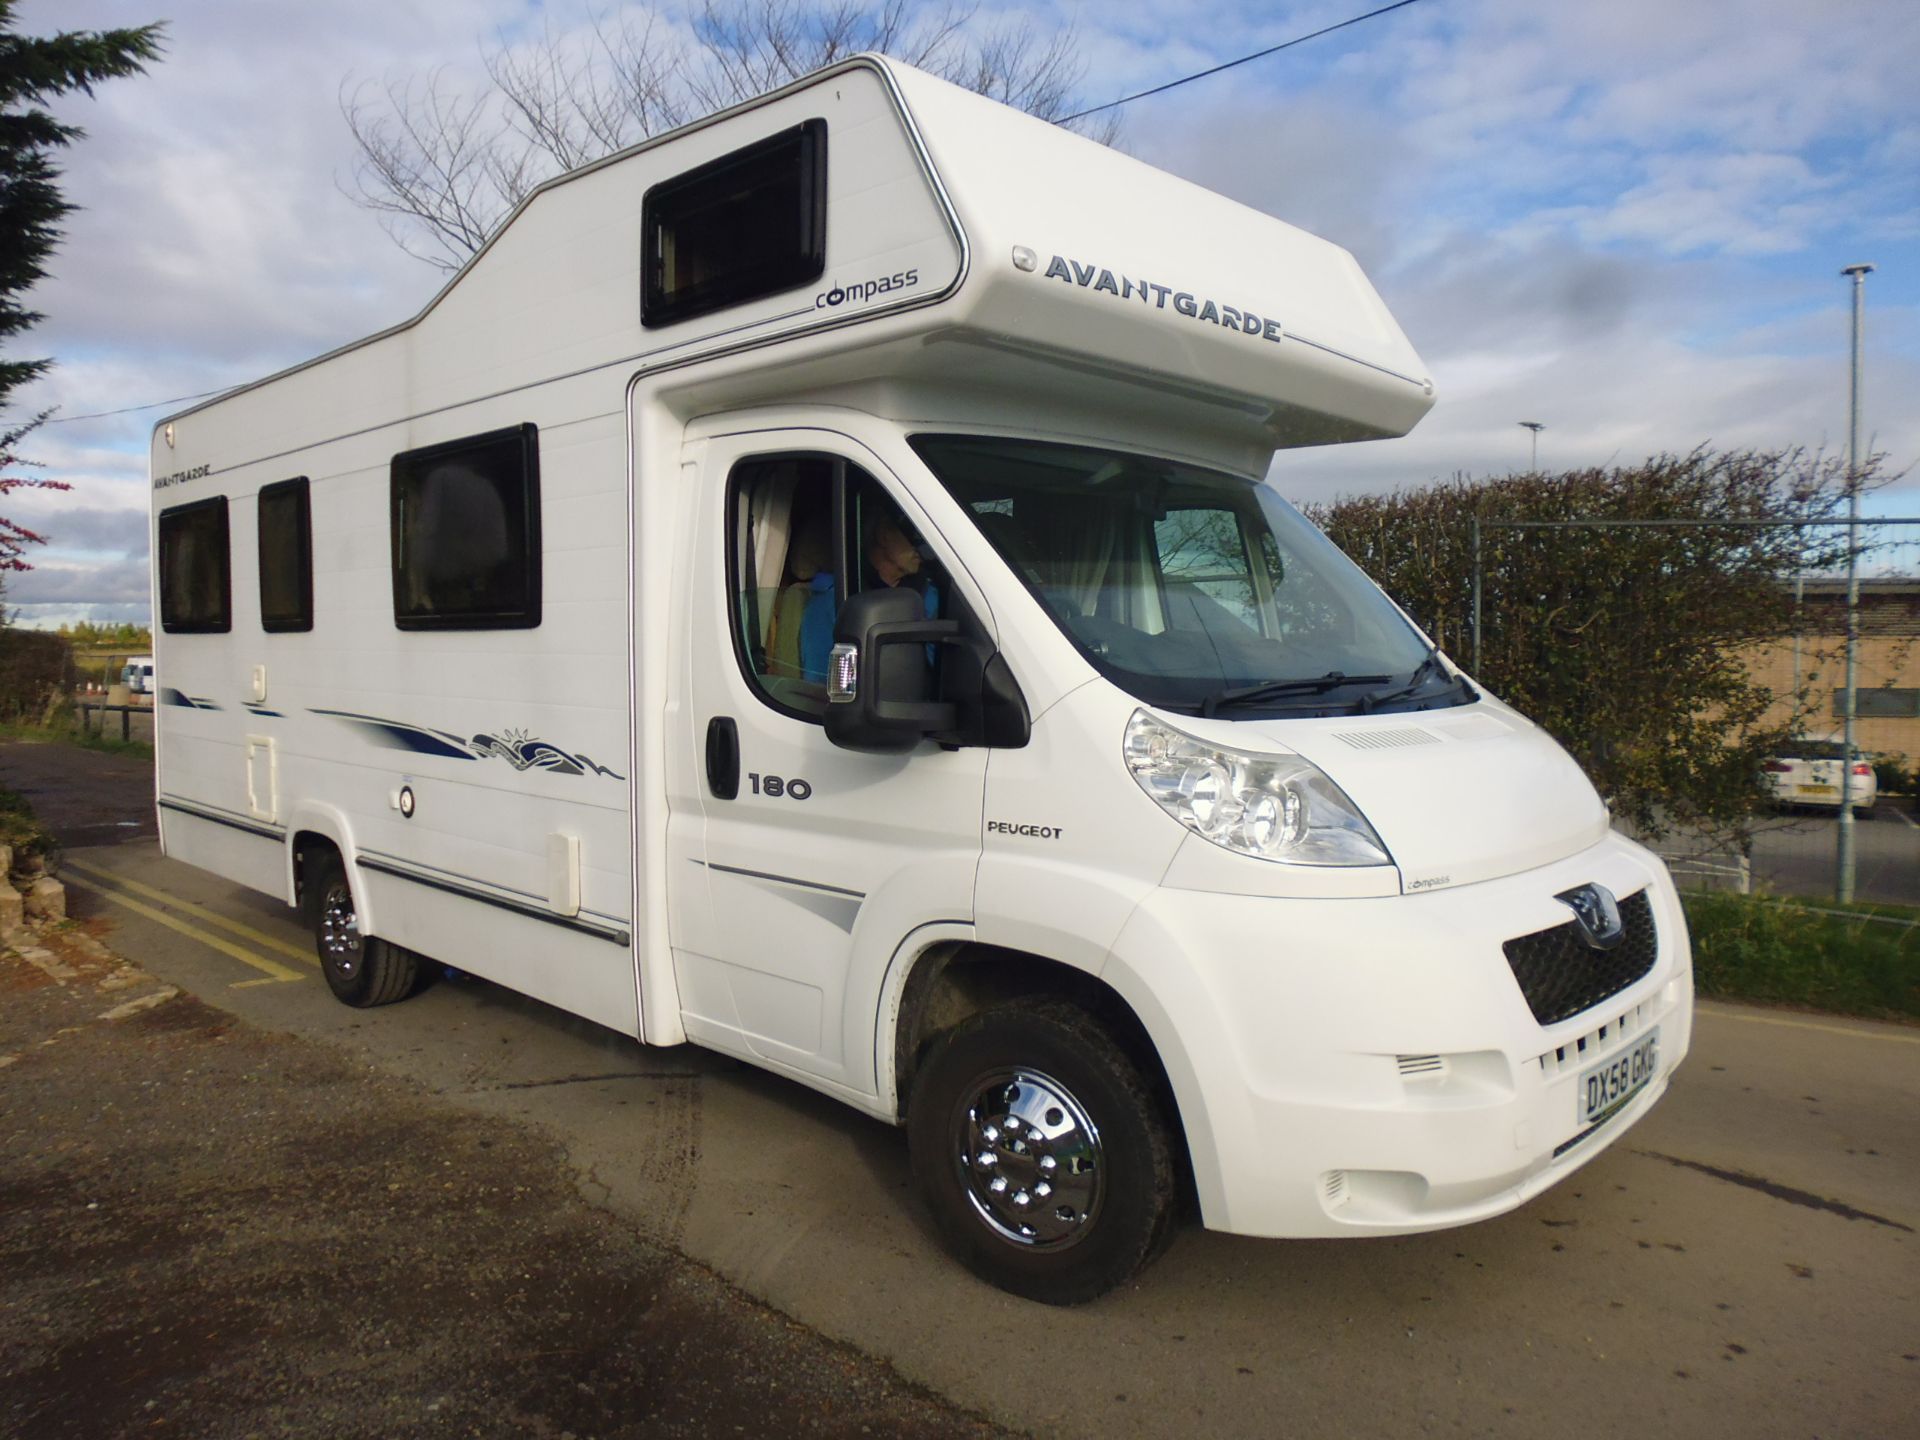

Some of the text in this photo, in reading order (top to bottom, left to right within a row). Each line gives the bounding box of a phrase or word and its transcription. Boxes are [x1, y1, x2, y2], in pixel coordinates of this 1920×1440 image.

[816, 269, 918, 308] compass
[1045, 255, 1281, 343] AVANTGARDE
[748, 772, 812, 800] 180
[987, 821, 1063, 839] PEUGEOT
[1587, 1057, 1629, 1114] DX58
